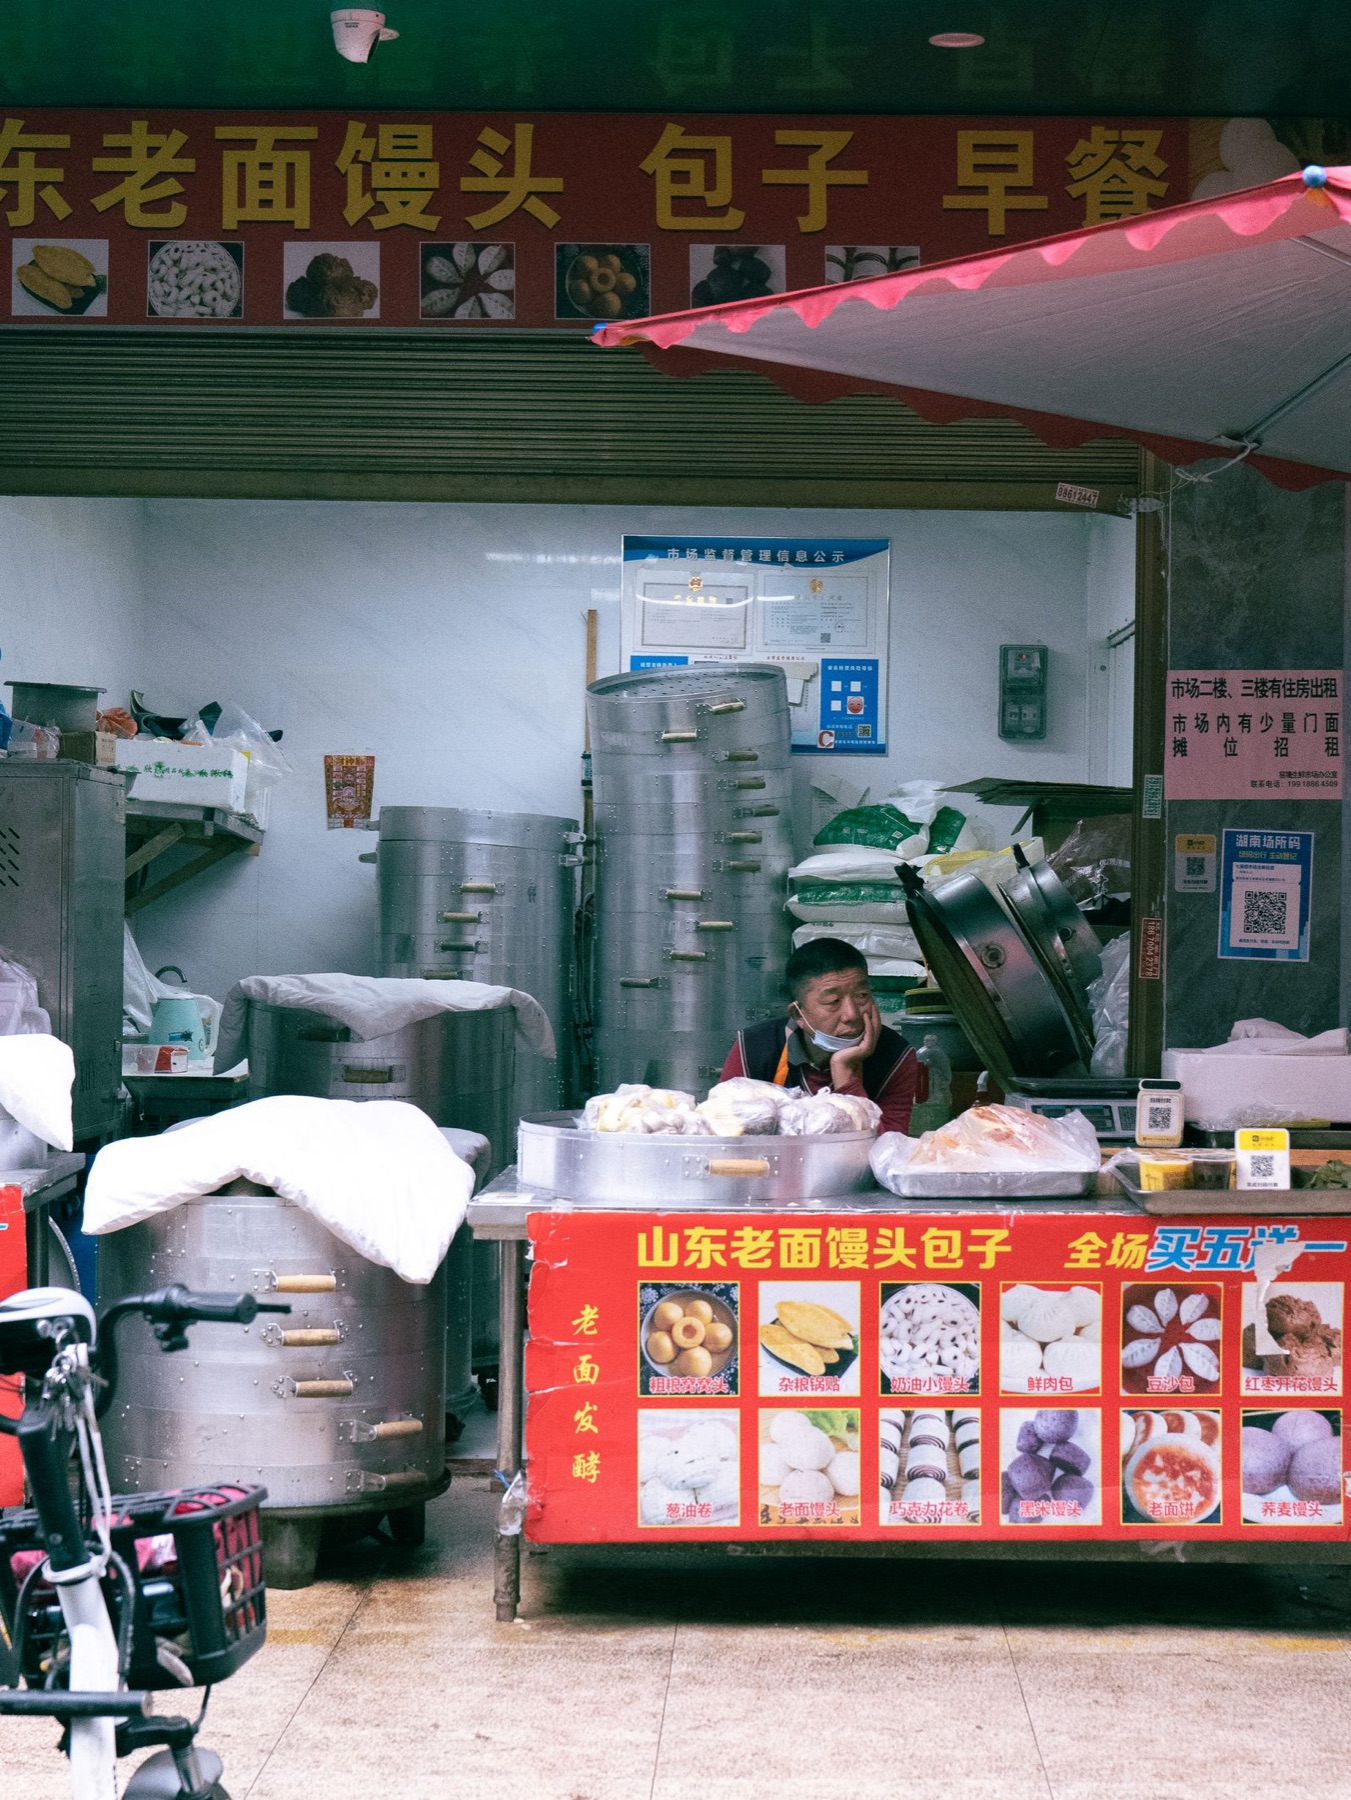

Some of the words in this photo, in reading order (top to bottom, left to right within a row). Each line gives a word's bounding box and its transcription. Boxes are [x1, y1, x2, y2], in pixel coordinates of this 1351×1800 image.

[0, 119, 564, 232] 东老面馒头
[639, 122, 869, 235] 包子
[943, 125, 1170, 237] 早餐
[1058, 487, 1098, 504] 88612447
[667, 547, 845, 564] 市场监督管理信息公示
[1171, 677, 1338, 699] 市场二楼、三楼有住房出租
[1172, 712, 1340, 734] 市场内有少量门面
[818, 731, 834, 747] C
[1172, 737, 1340, 758] 摊位招租
[1235, 834, 1301, 850] 湖南场所码
[1147, 921, 1155, 935] 186
[637, 1226, 1012, 1270] 山东老面馒头包子
[649, 1376, 729, 1394] 粗粮窝窝头
[778, 1377, 841, 1392] 杂粮锅贴
[890, 1377, 969, 1393] 奶油小馒头
[1027, 1376, 1073, 1392] 鲜肉包
[1147, 1376, 1195, 1392] 豆沙包
[1245, 1376, 1338, 1392] 红枣开花馒头
[571, 1304, 601, 1484] 老面发酵
[666, 1502, 712, 1519] 葱油卷
[778, 1502, 840, 1518] 老面馒头
[890, 1502, 969, 1518] 巧克力花卷
[1019, 1501, 1082, 1518] 黑米馒头
[1148, 1501, 1195, 1517] 老面饼
[1261, 1501, 1323, 1517] 荞麦馒头
